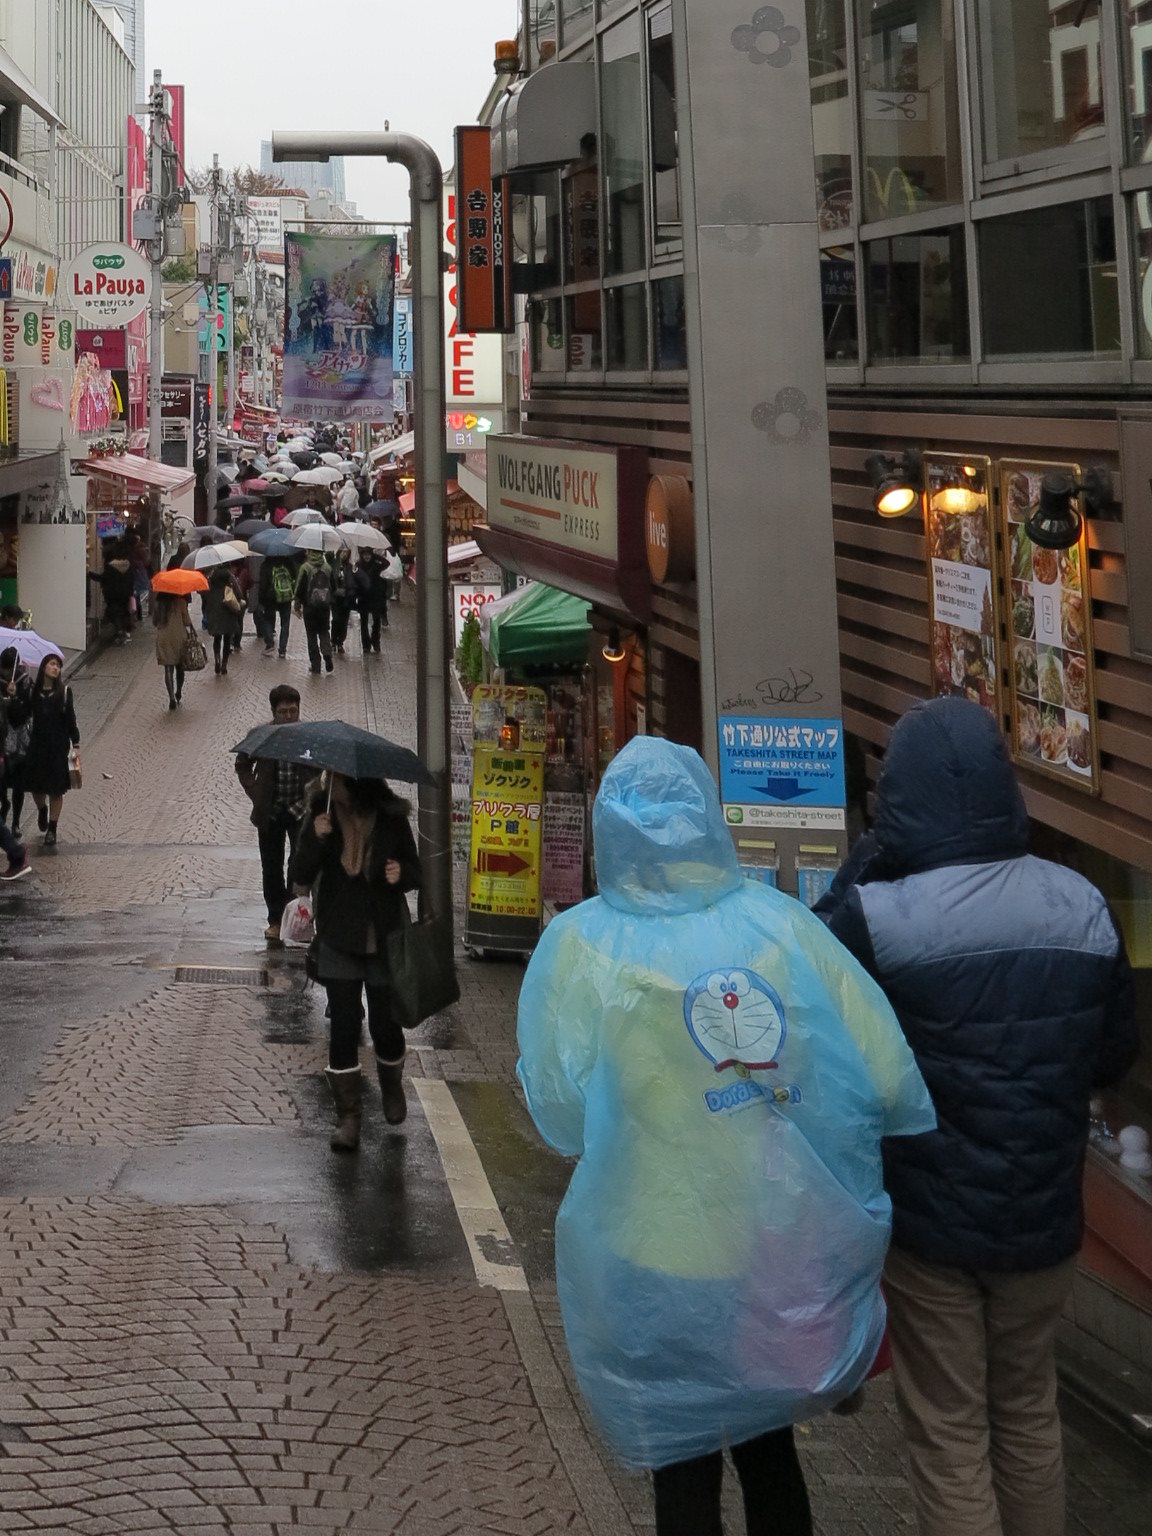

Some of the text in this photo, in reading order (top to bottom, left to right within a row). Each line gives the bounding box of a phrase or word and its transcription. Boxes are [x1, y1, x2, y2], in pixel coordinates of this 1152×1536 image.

[467, 189, 489, 268] 吉野家
[74, 272, 145, 297] La Pausa
[3, 308, 20, 363] La Pausa
[42, 316, 56, 364] La Pausa
[398, 313, 408, 370] コインロッカー
[292, 403, 384, 417] 原宿竹下通り商店会
[455, 432, 473, 446] B1
[498, 454, 599, 509] WOLFGANG PUCK
[564, 514, 600, 541] EXPRESS
[726, 748, 837, 760] TAKESHITA STREET MAP
[473, 799, 542, 821] プリクラ屋
